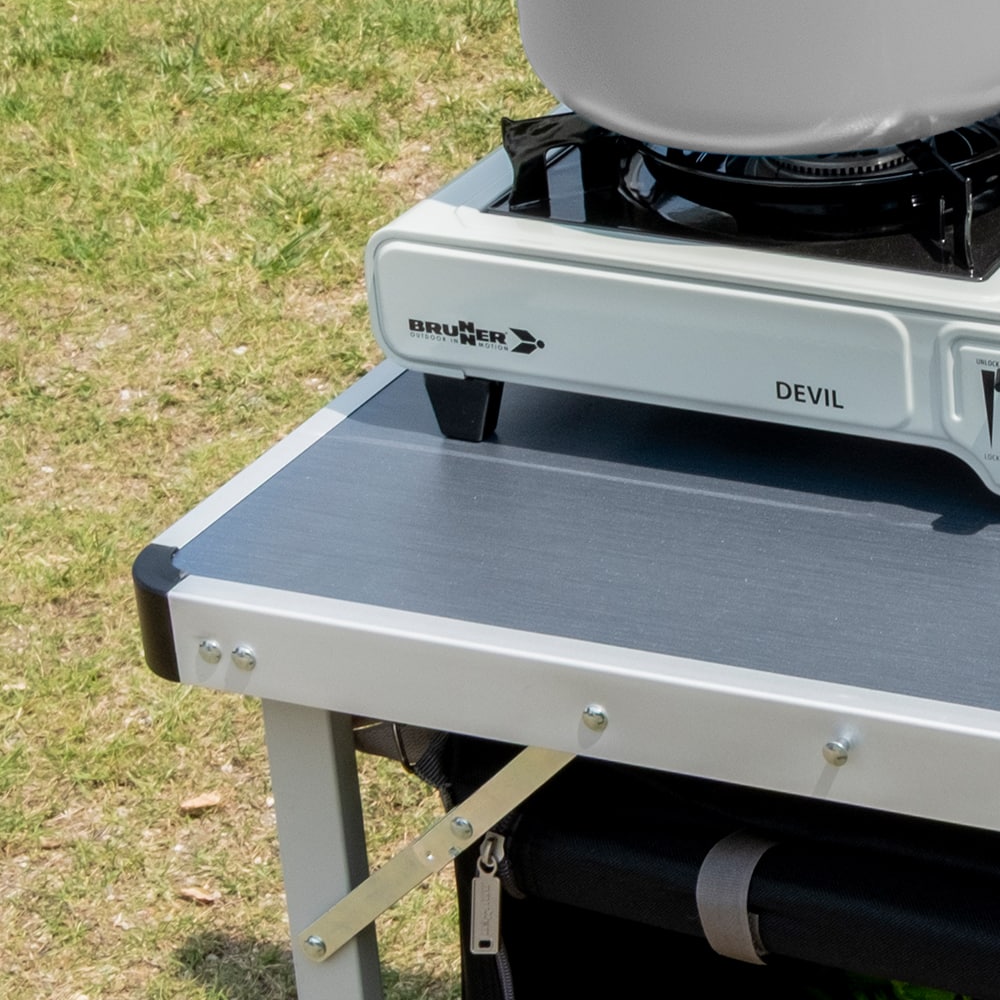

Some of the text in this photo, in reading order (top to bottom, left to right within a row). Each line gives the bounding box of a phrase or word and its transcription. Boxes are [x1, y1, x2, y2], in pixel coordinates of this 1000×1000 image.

[408, 318, 507, 346] BRUNNER
[478, 341, 509, 351] MOTION
[975, 358, 999, 367] UNLOCK
[776, 380, 844, 409] DEVIL
